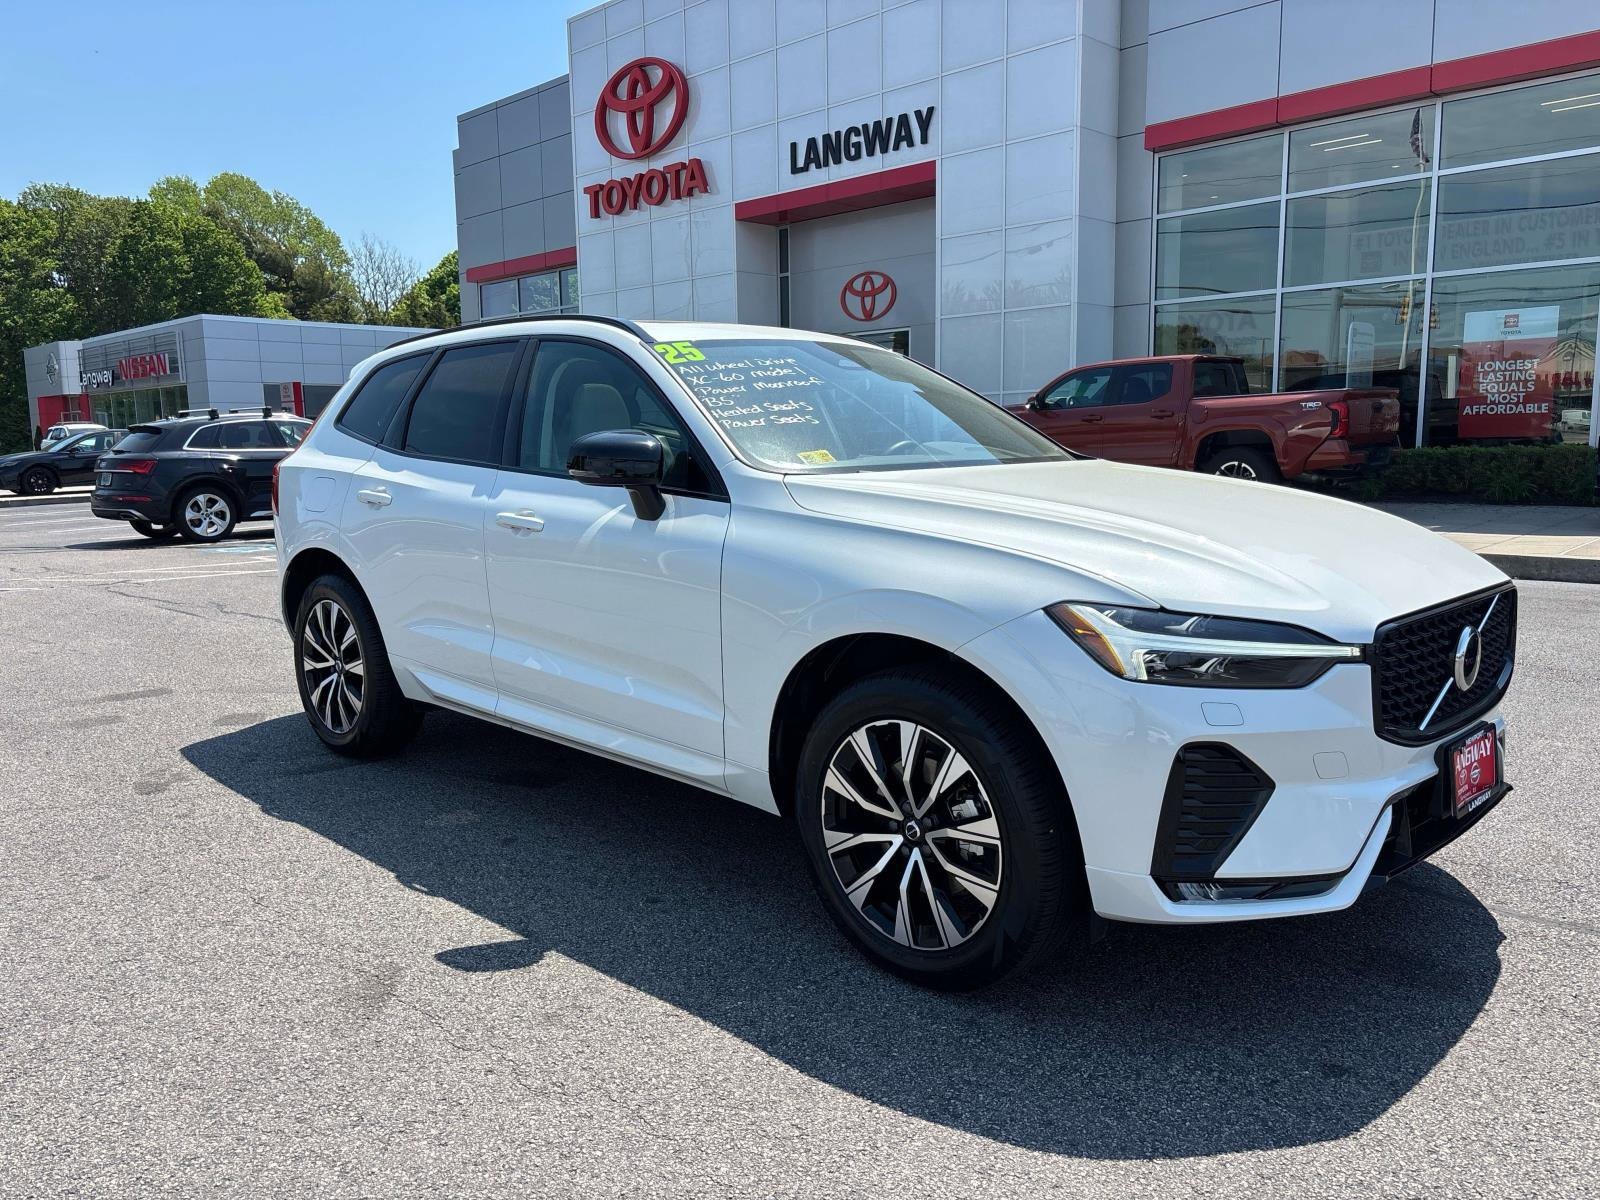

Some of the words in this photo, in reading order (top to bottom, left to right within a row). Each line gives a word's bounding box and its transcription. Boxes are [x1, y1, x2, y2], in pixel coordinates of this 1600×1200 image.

[789, 106, 935, 175] LANGWAY
[583, 157, 711, 219] TOYOTA
[1377, 227, 1427, 248] TOYOA
[1495, 215, 1512, 235] IN
[1393, 250, 1409, 266] IN
[1416, 245, 1447, 263] NW
[1543, 232, 1566, 251] #5
[1572, 229, 1590, 248] IN
[653, 342, 705, 364] 25
[80, 370, 113, 388] Langway
[118, 353, 170, 381] NISSAN
[679, 364, 704, 374] All
[705, 360, 755, 371] Wheel
[1477, 359, 1539, 372] LONGEST
[687, 372, 745, 385] XC-60
[1479, 370, 1537, 383] LASTING
[695, 386, 747, 395] Power
[1479, 381, 1535, 394] EQUALS
[1300, 401, 1322, 409] TRD
[1487, 393, 1526, 404] MOST
[1462, 403, 1549, 416] AFFORDABLE
[719, 418, 765, 429] Power
[1468, 789, 1492, 812] LANGWAY
